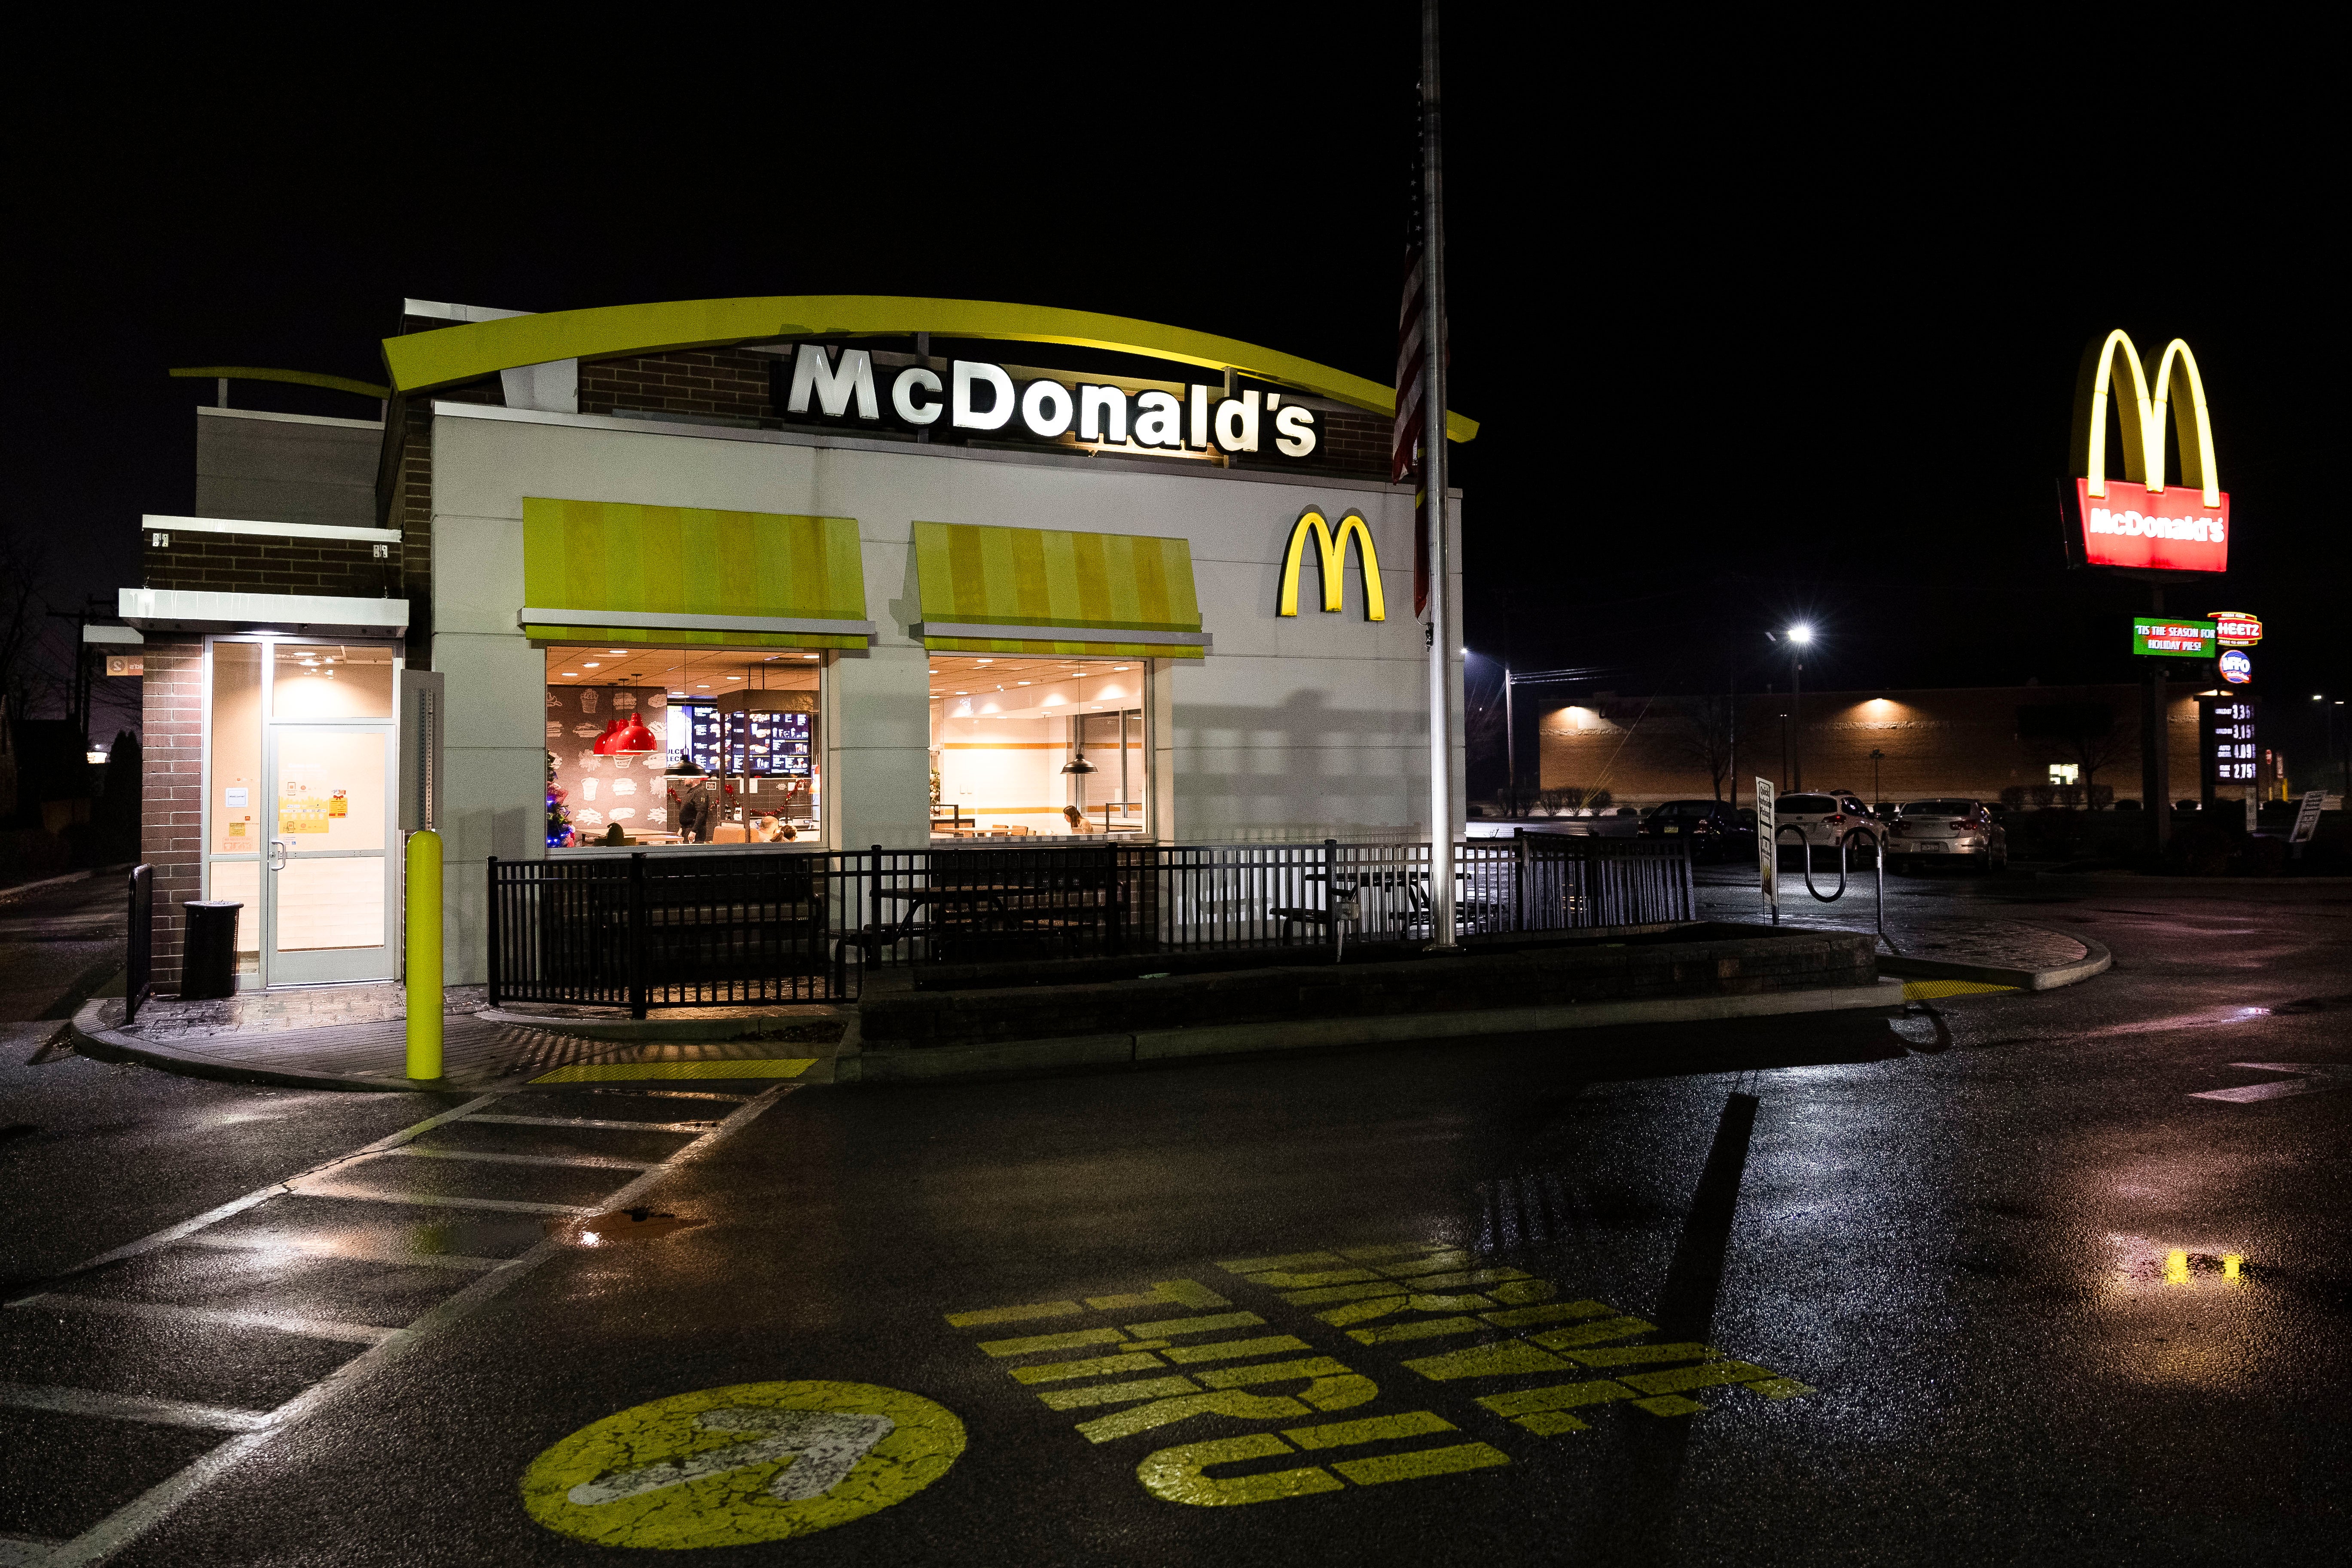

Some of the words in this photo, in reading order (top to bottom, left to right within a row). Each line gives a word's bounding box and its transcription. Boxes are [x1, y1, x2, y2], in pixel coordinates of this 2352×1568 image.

[787, 344, 1316, 457] McDonald's
[2090, 507, 2224, 543] McDonald's
[2148, 640, 2181, 650] HOLIDAY
[2182, 641, 2201, 651] PIES!
[2152, 626, 2166, 636] THE
[2169, 627, 2198, 638] SEASON
[2200, 629, 2215, 638] FOR
[2217, 622, 2259, 636] HEETZ
[1213, 1242, 1819, 1437] DRIVE
[944, 1278, 1512, 1507] THRU
